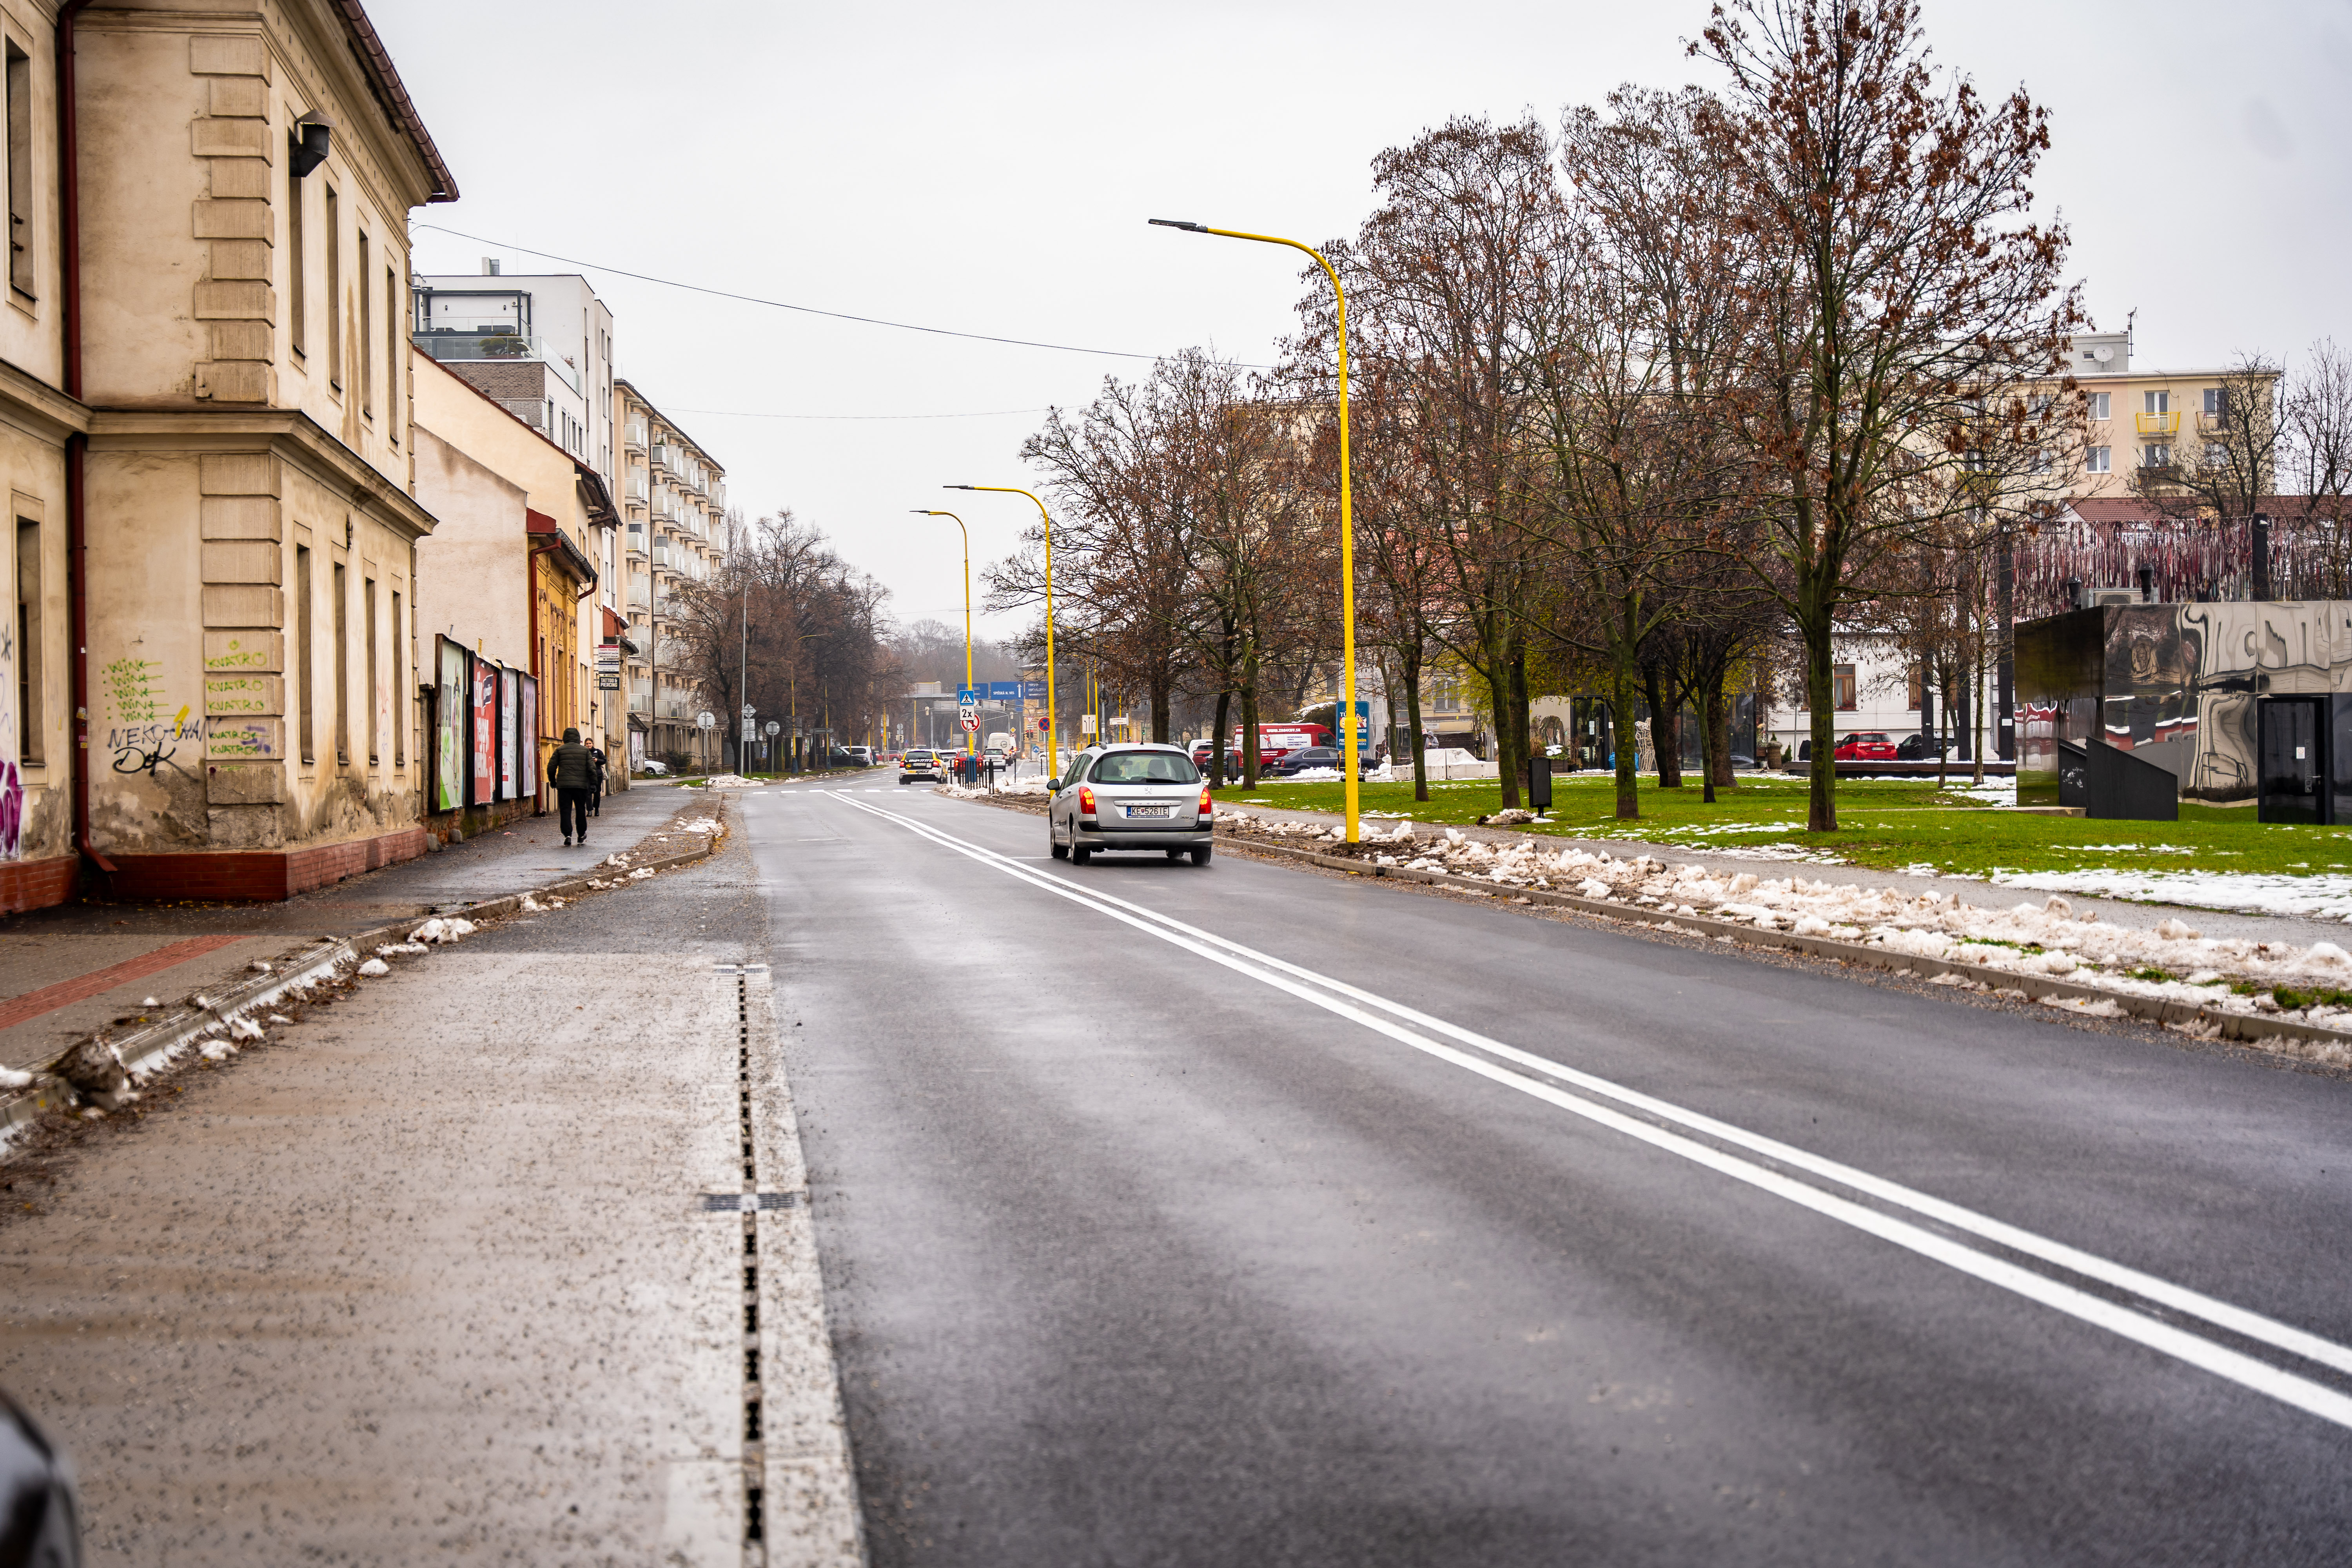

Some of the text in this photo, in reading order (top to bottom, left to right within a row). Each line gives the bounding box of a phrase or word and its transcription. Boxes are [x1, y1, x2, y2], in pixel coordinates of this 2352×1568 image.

[204, 652, 267, 668] KVATRO
[206, 680, 263, 693] KVATRO
[207, 699, 263, 714] KVATRO
[962, 709, 972, 718] 2x
